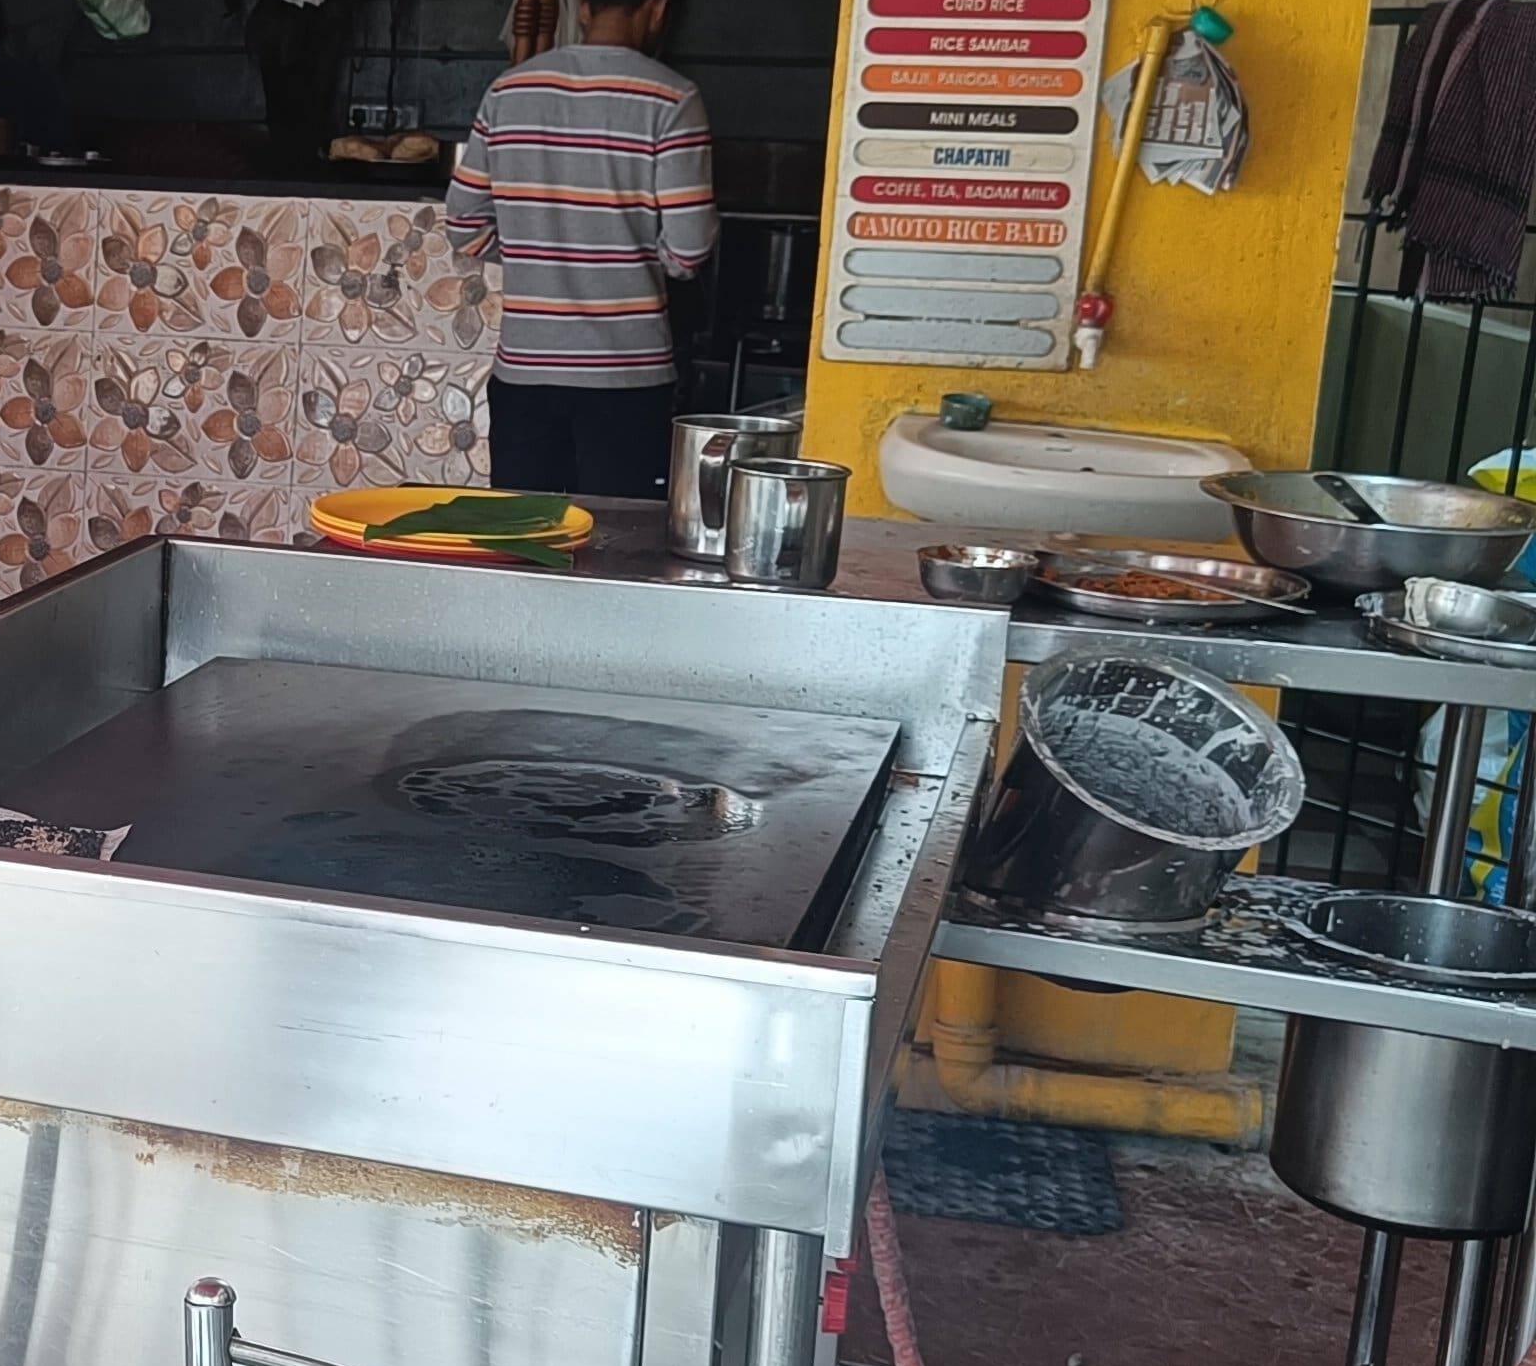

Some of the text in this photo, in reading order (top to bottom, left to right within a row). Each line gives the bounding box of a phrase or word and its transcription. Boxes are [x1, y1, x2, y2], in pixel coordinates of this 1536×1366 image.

[929, 36, 1031, 53] RICE SAMBAR
[929, 111, 1017, 128] MINI MEALS
[933, 146, 1010, 168] CHAPATHI
[1021, 187, 1061, 203] MILK
[947, 218, 1000, 243] RICE
